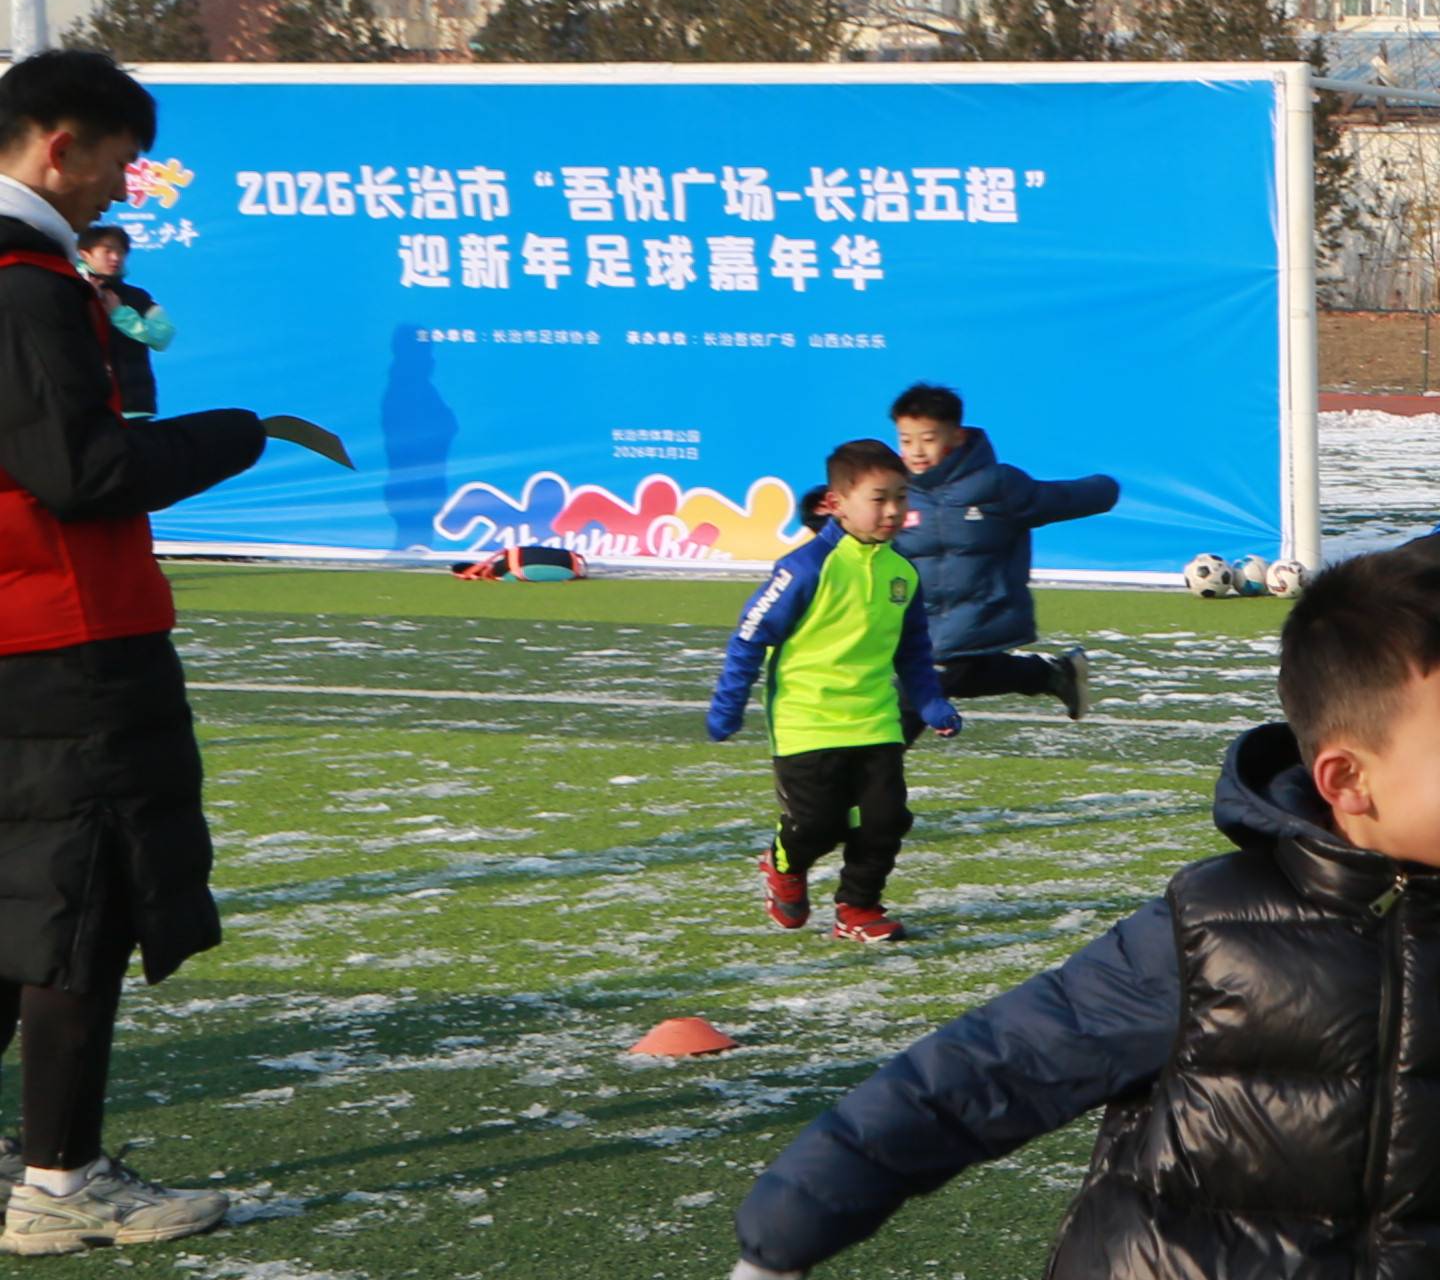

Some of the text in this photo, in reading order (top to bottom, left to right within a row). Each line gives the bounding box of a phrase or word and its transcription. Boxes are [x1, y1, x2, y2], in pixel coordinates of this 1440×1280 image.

[399, 232, 884, 291] 迎新年足球嘉年华
